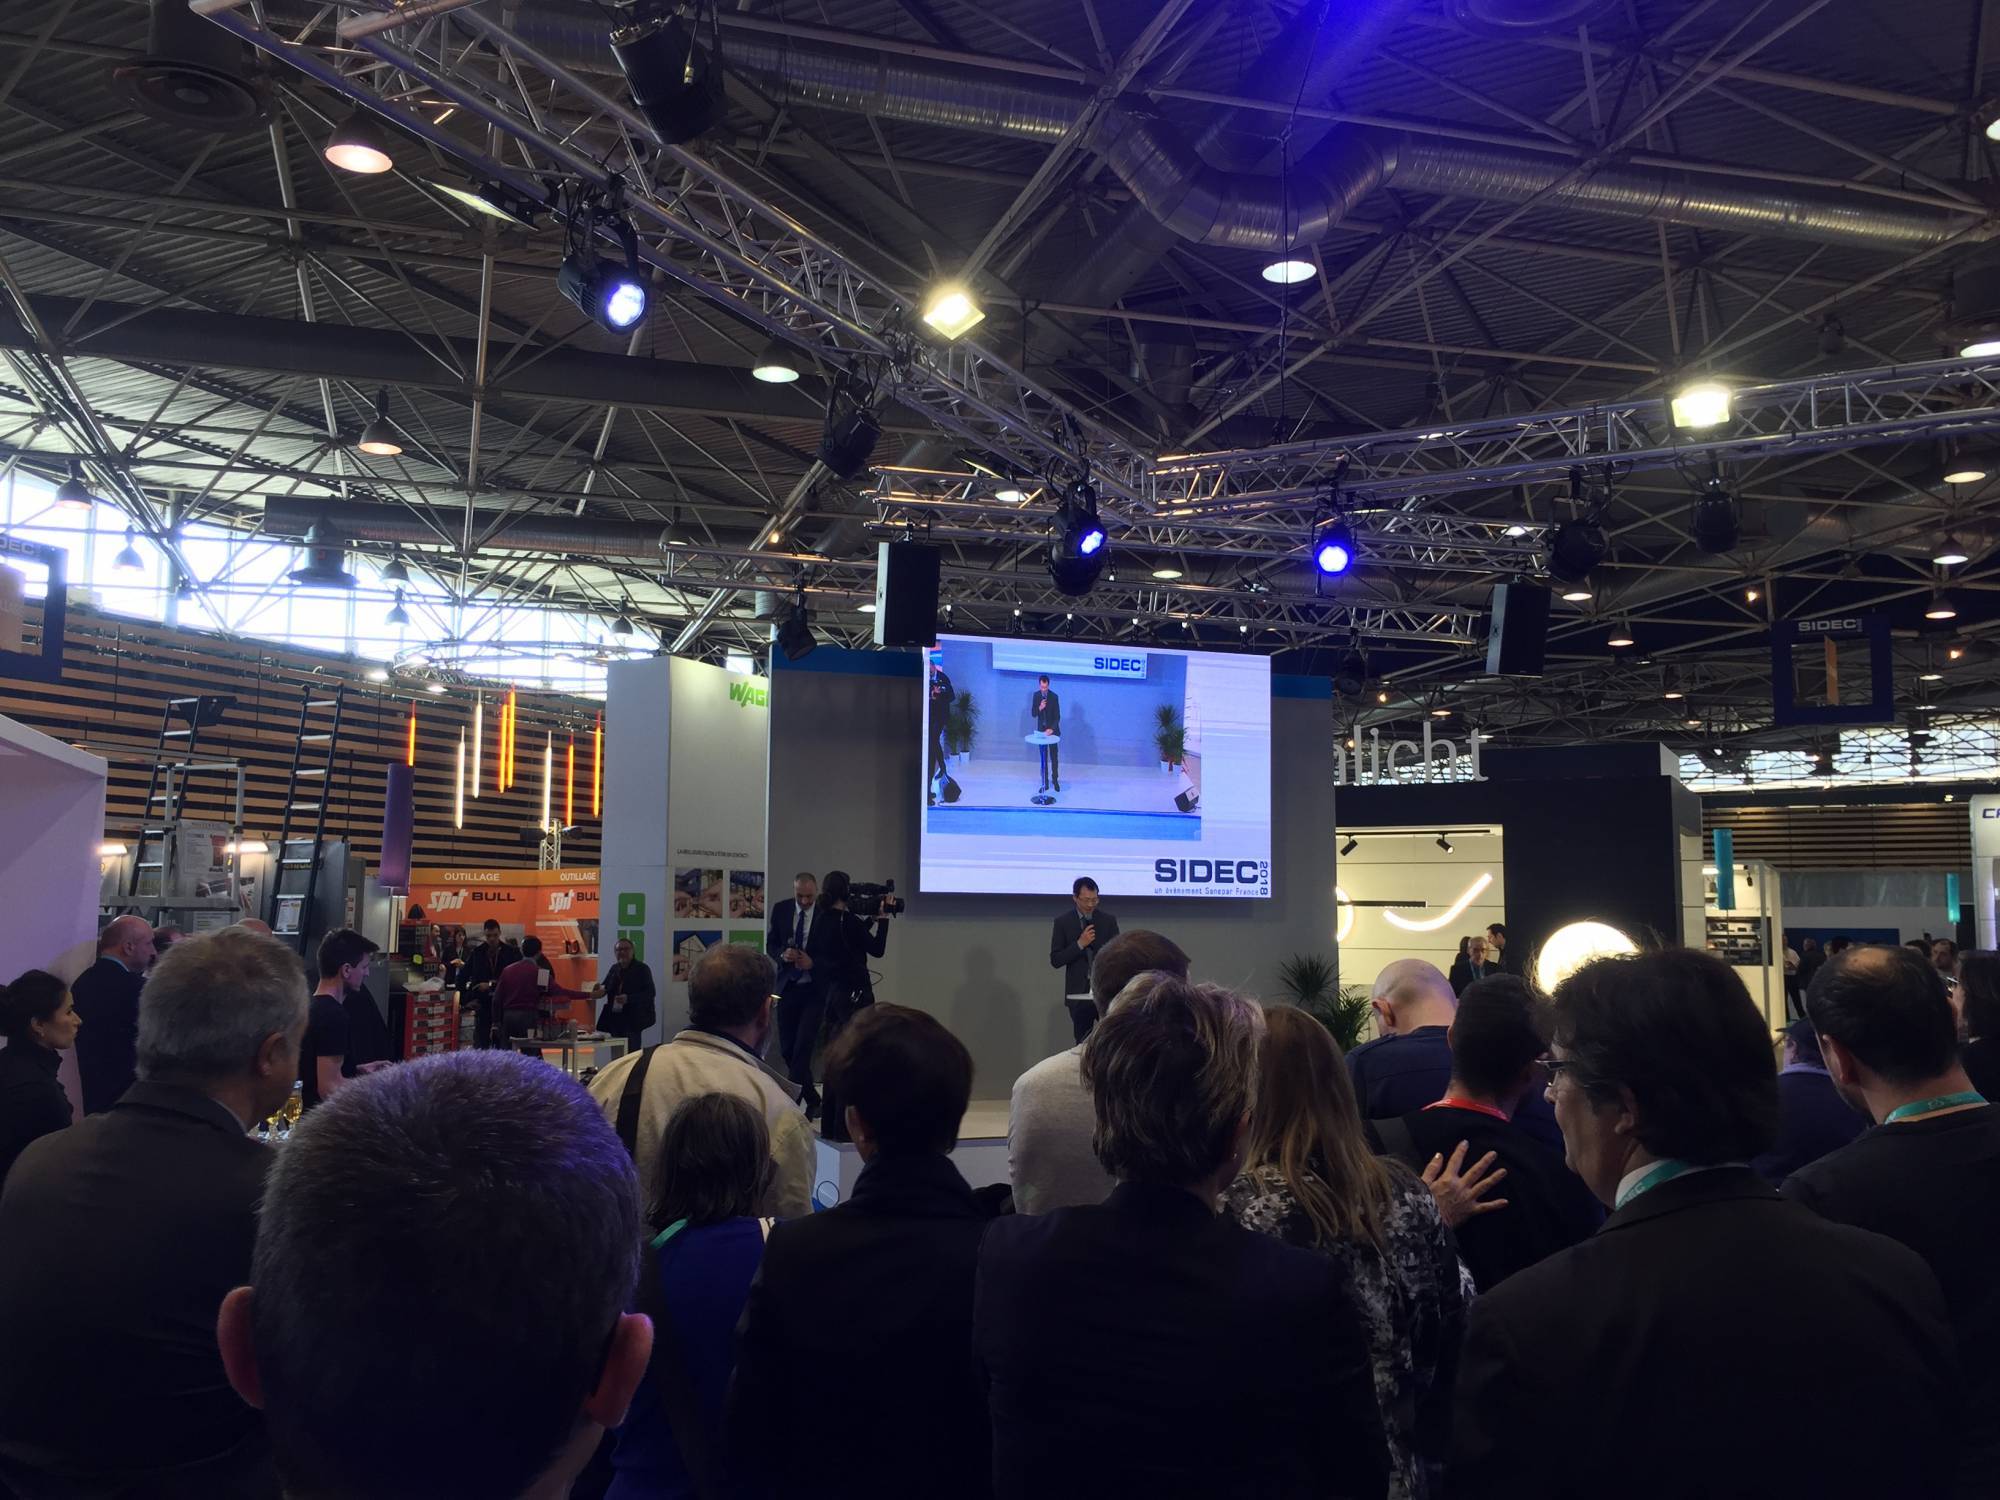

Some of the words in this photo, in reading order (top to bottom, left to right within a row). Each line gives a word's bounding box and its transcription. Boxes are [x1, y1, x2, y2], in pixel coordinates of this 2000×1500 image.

[1798, 619, 1857, 631] SIDEC
[1094, 657, 1141, 671] SIDEC
[730, 682, 768, 707] WAG
[444, 872, 500, 881] OUTILLAGE
[560, 872, 597, 881] OUTILLAGE
[1155, 858, 1259, 884] SIDEC
[1259, 861, 1269, 896] 2018
[471, 892, 516, 901] BULL
[1235, 887, 1259, 896] France
